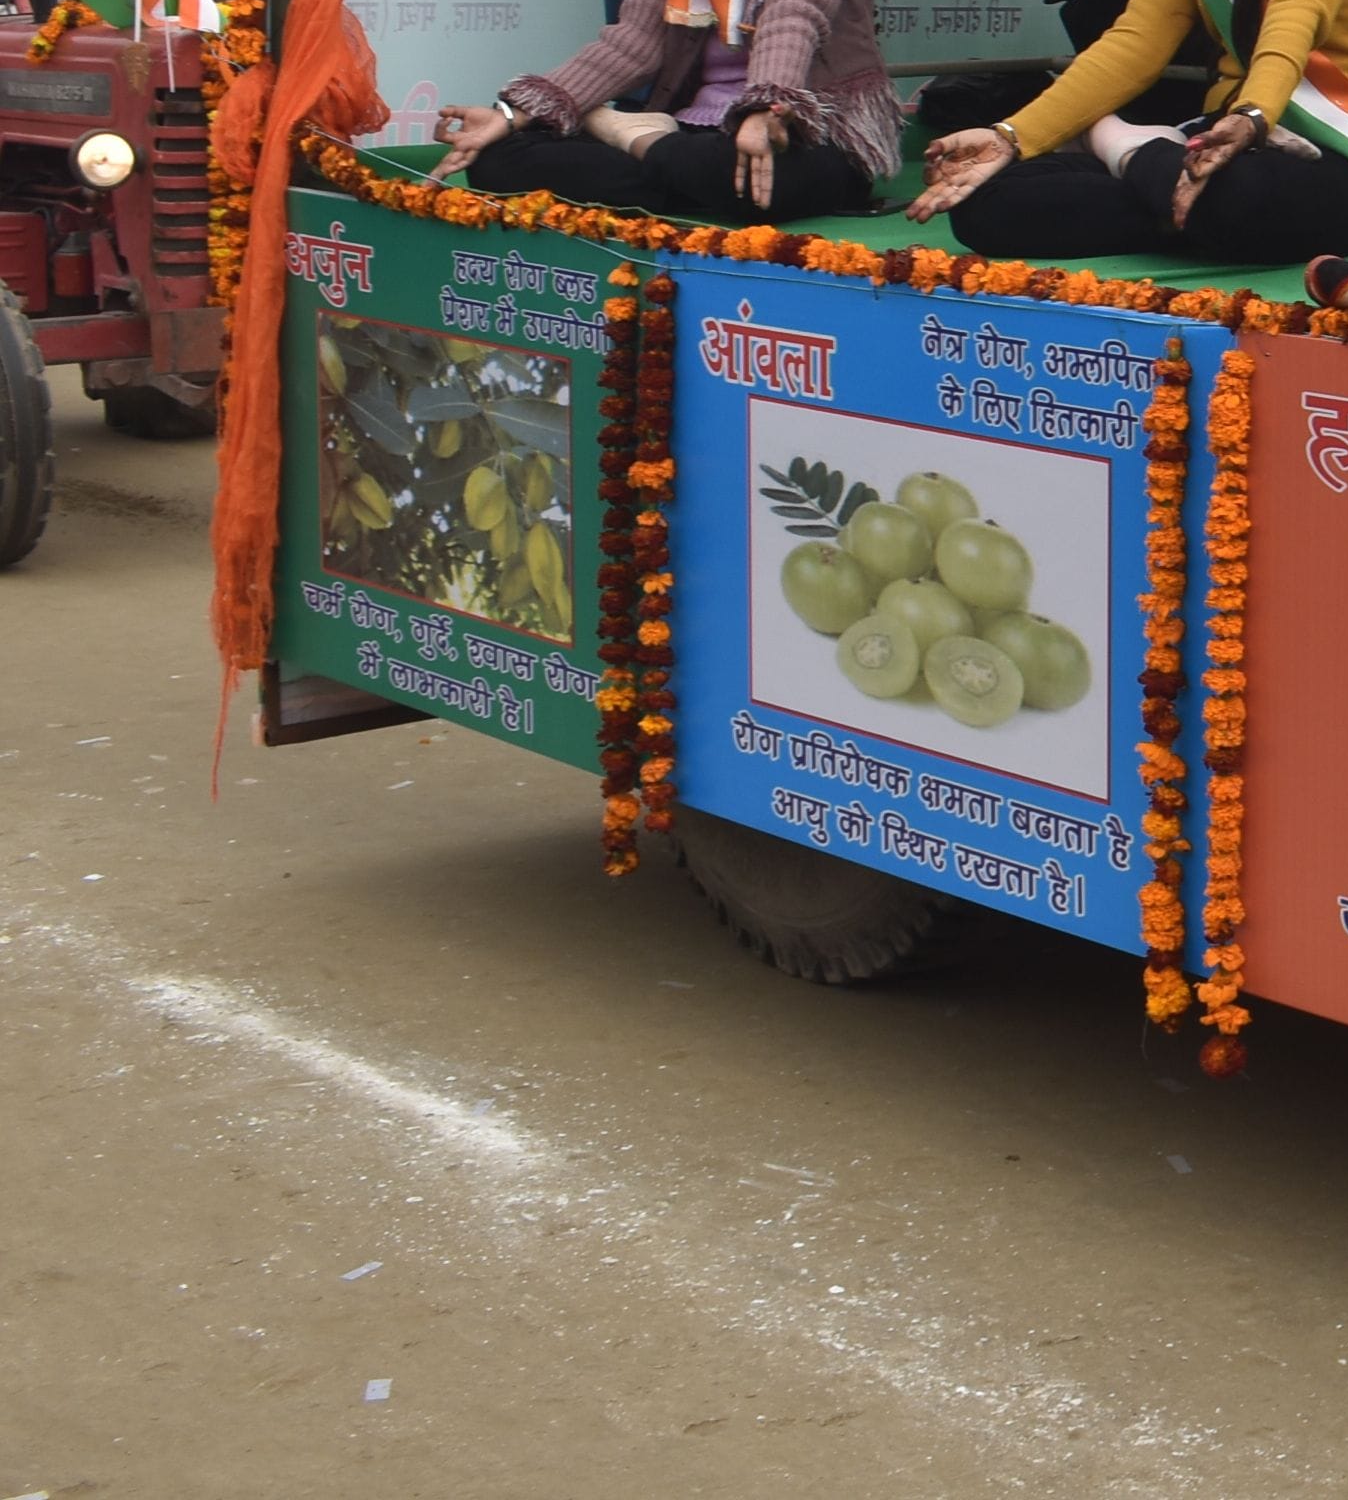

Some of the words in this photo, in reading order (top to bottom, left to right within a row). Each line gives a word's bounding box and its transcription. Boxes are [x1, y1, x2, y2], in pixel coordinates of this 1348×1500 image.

[286, 221, 373, 307] अर्जुन
[502, 250, 548, 294] रोग
[494, 293, 517, 336] में
[522, 308, 609, 355] उपयोगी
[701, 299, 836, 399] आंवला
[921, 315, 966, 363] नेत्र
[976, 322, 1034, 379] रोग,
[938, 376, 965, 417] के
[972, 379, 1022, 434] लिए
[1030, 389, 1139, 449] हितकारी
[302, 581, 344, 618] चर्म
[351, 590, 402, 642] रोग,
[464, 633, 537, 680] श्वास
[544, 652, 601, 701] रोग
[357, 640, 382, 679] में
[388, 657, 493, 718] लाभकारी
[731, 712, 783, 762] रोग
[790, 732, 911, 798] प्रतिरोधक
[919, 774, 1003, 828] क्षमता
[1104, 813, 1134, 871] है
[772, 787, 830, 846] आयु
[836, 801, 872, 845] को
[881, 811, 948, 873] स्थिर
[955, 842, 1040, 900] रखता
